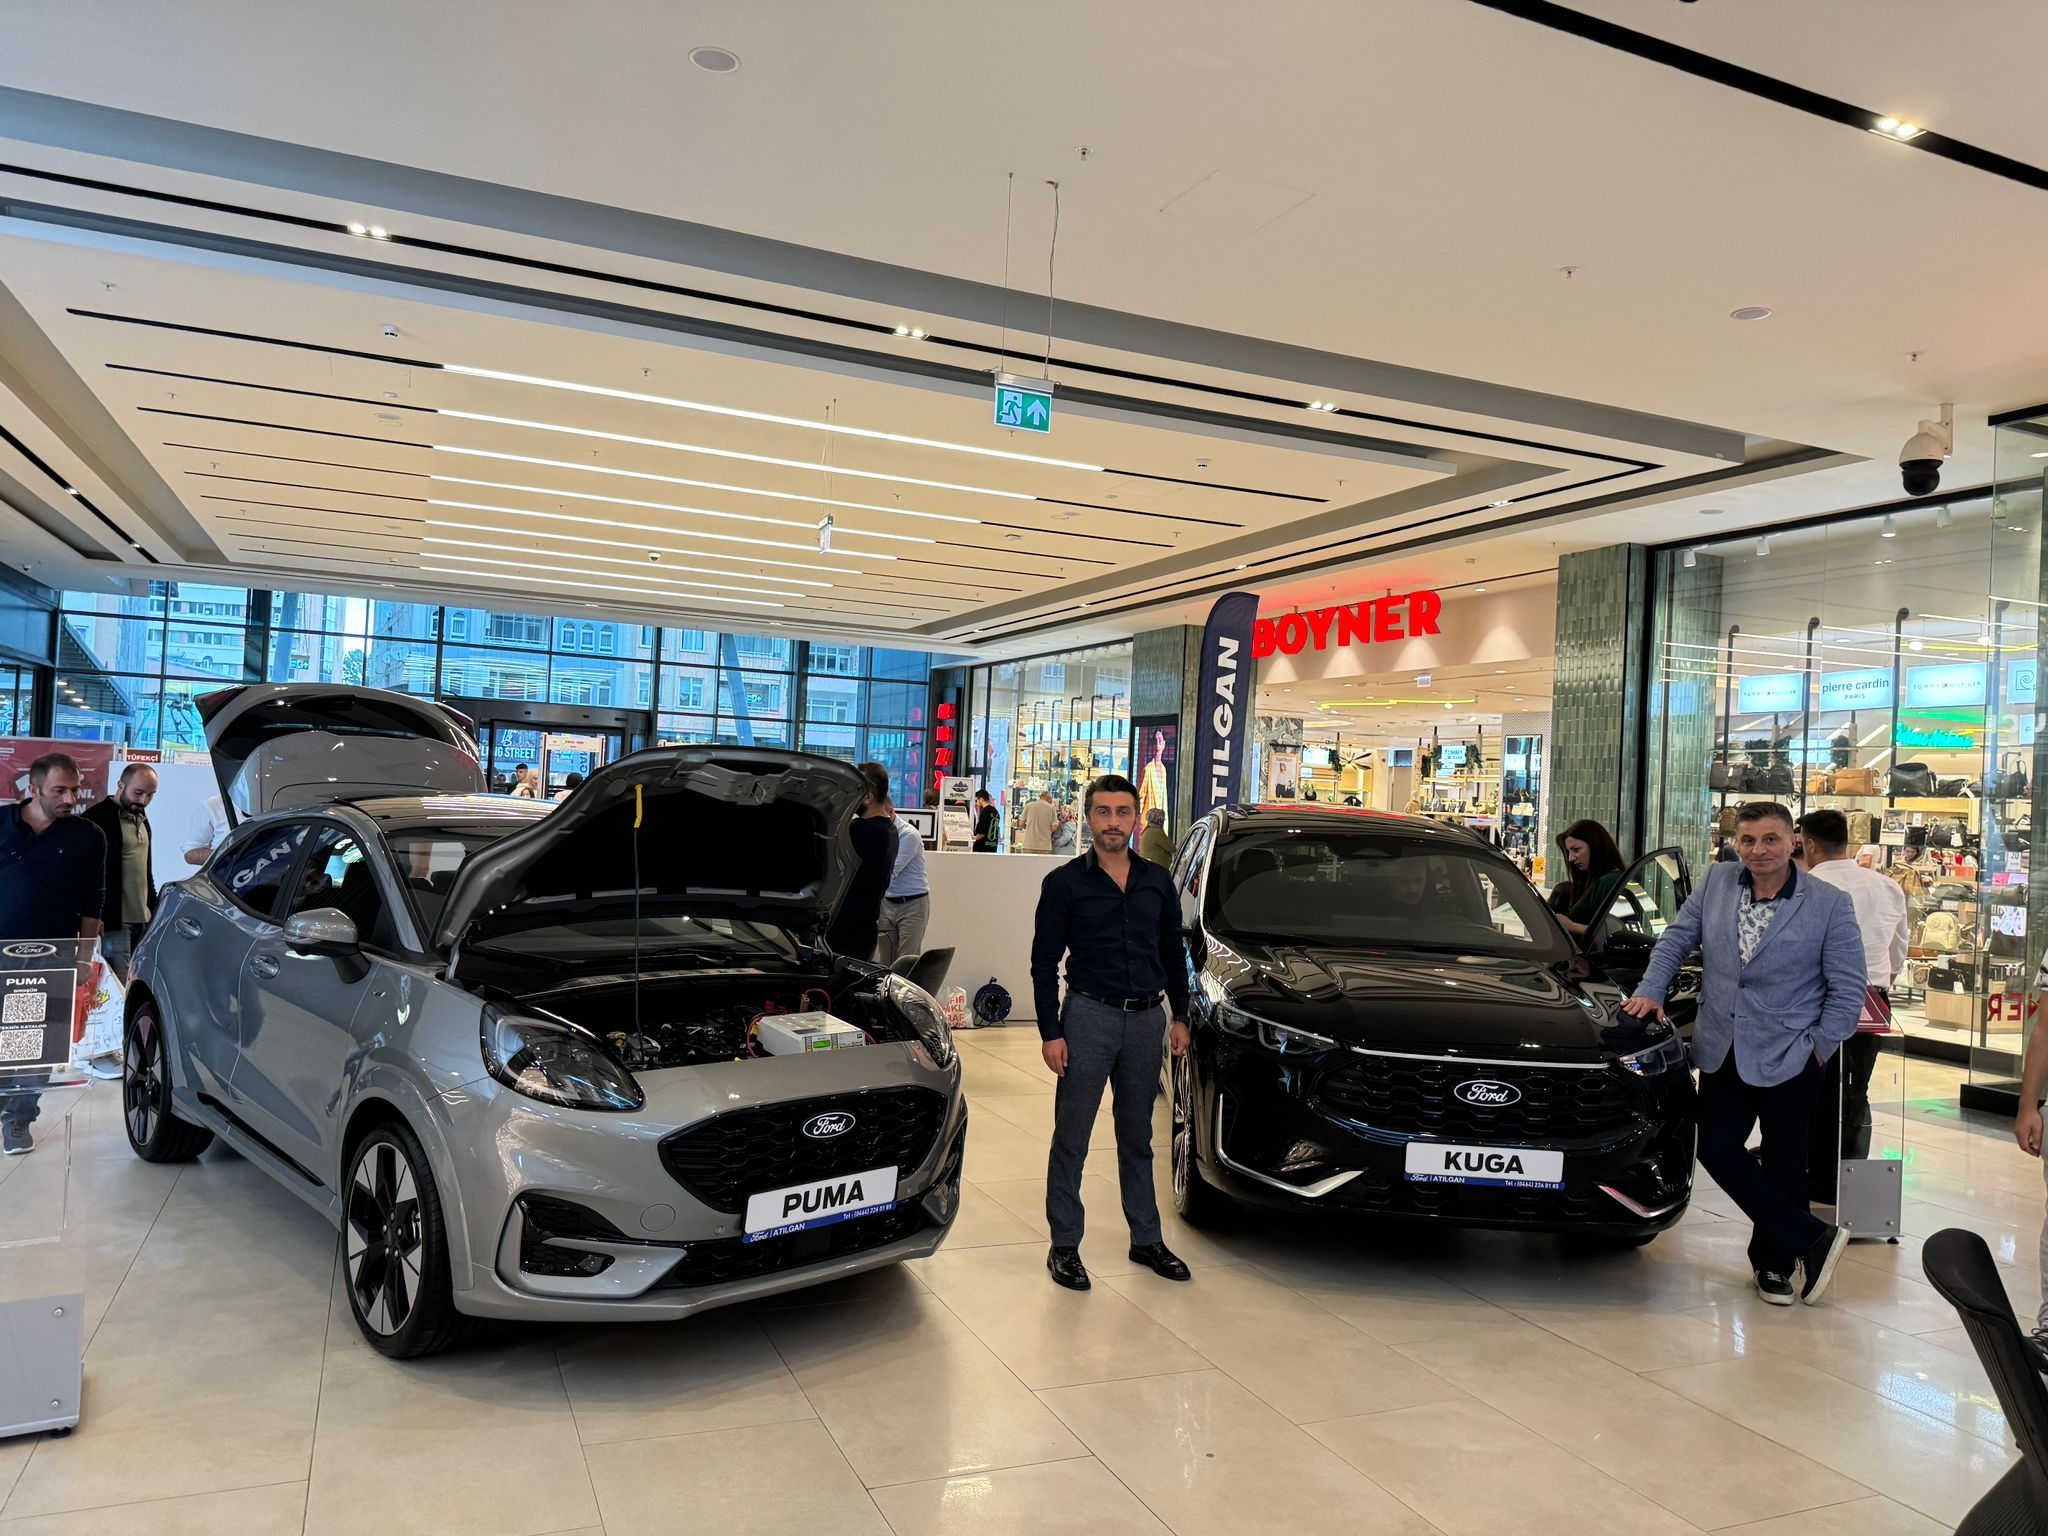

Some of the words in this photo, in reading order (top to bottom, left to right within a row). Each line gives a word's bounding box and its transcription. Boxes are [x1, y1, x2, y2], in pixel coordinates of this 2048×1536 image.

[1252, 590, 1442, 659] BOYNER
[1822, 681, 1853, 694] pierre
[1855, 677, 1889, 690] cardin
[1211, 636, 1240, 807] TILGAN
[504, 746, 536, 759] STREET
[6, 977, 47, 986] PUMA
[1444, 1151, 1525, 1175] KUGA
[1432, 1176, 1465, 1184] ATILGAN
[782, 1179, 865, 1219] PUMA
[772, 1222, 806, 1238] ATILGAN
